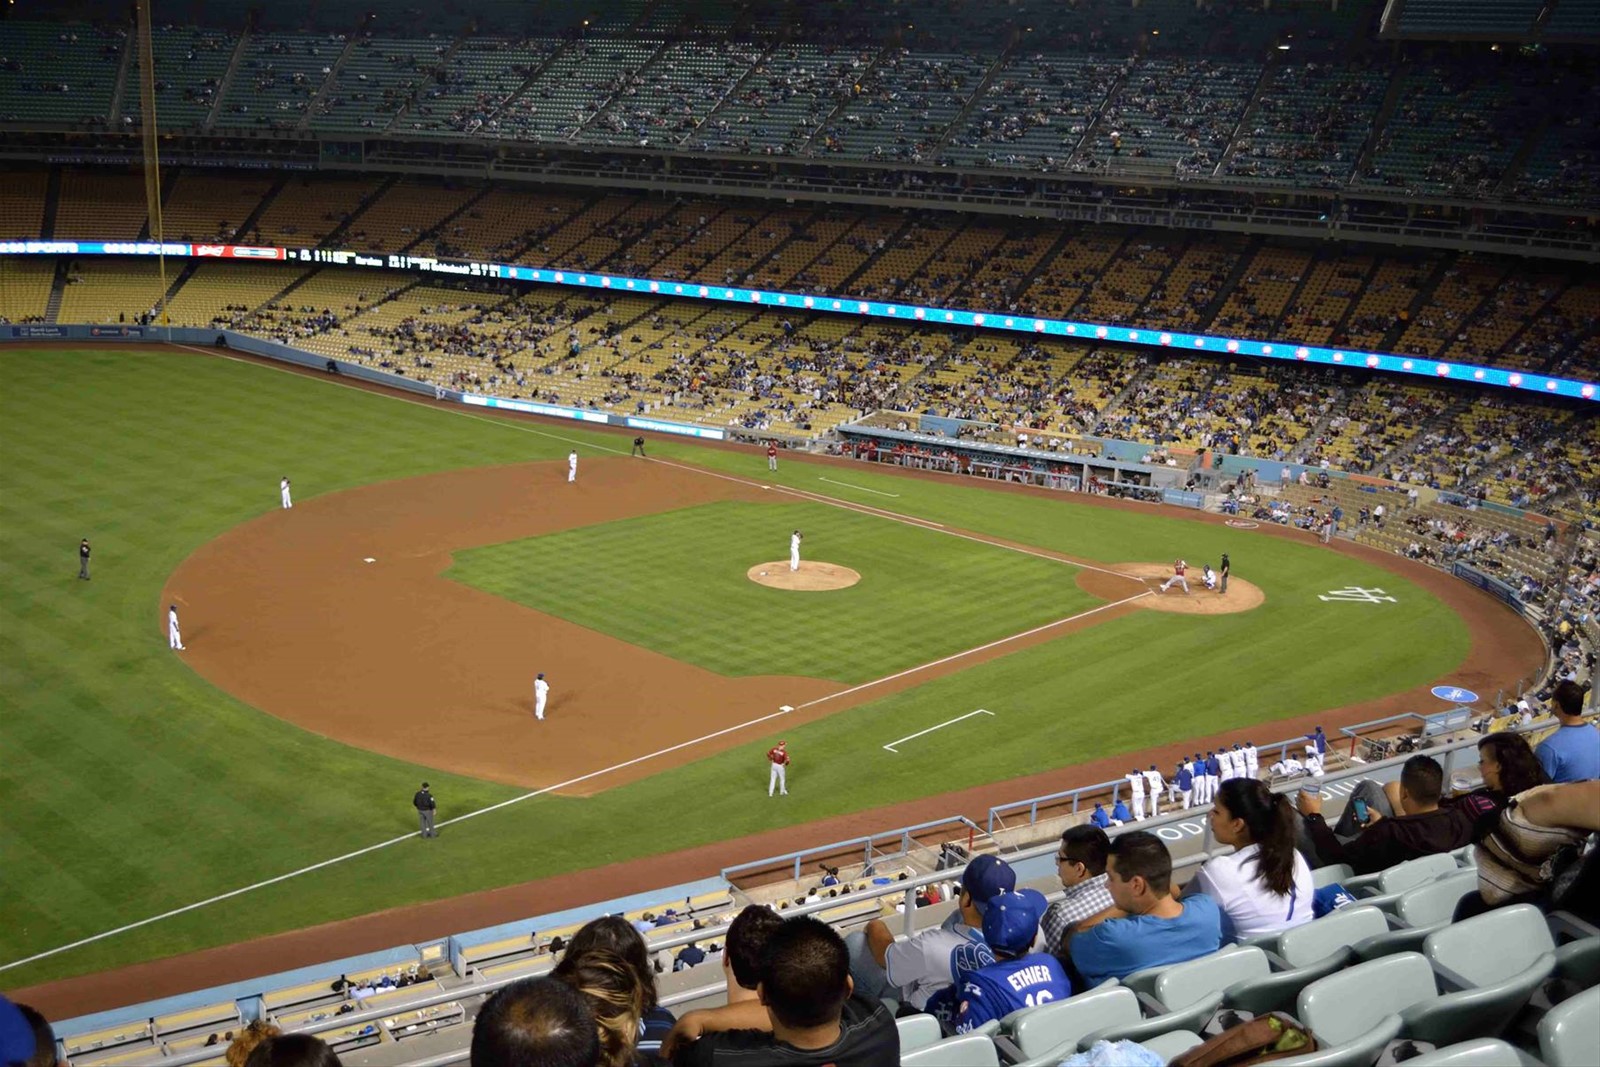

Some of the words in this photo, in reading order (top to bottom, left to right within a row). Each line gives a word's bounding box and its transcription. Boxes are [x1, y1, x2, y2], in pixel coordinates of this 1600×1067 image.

[1056, 210, 1107, 221] UNITED
[1122, 214, 1157, 224] CLUB
[1163, 217, 1213, 228] SUITES
[1007, 965, 1052, 991] ETHIER
